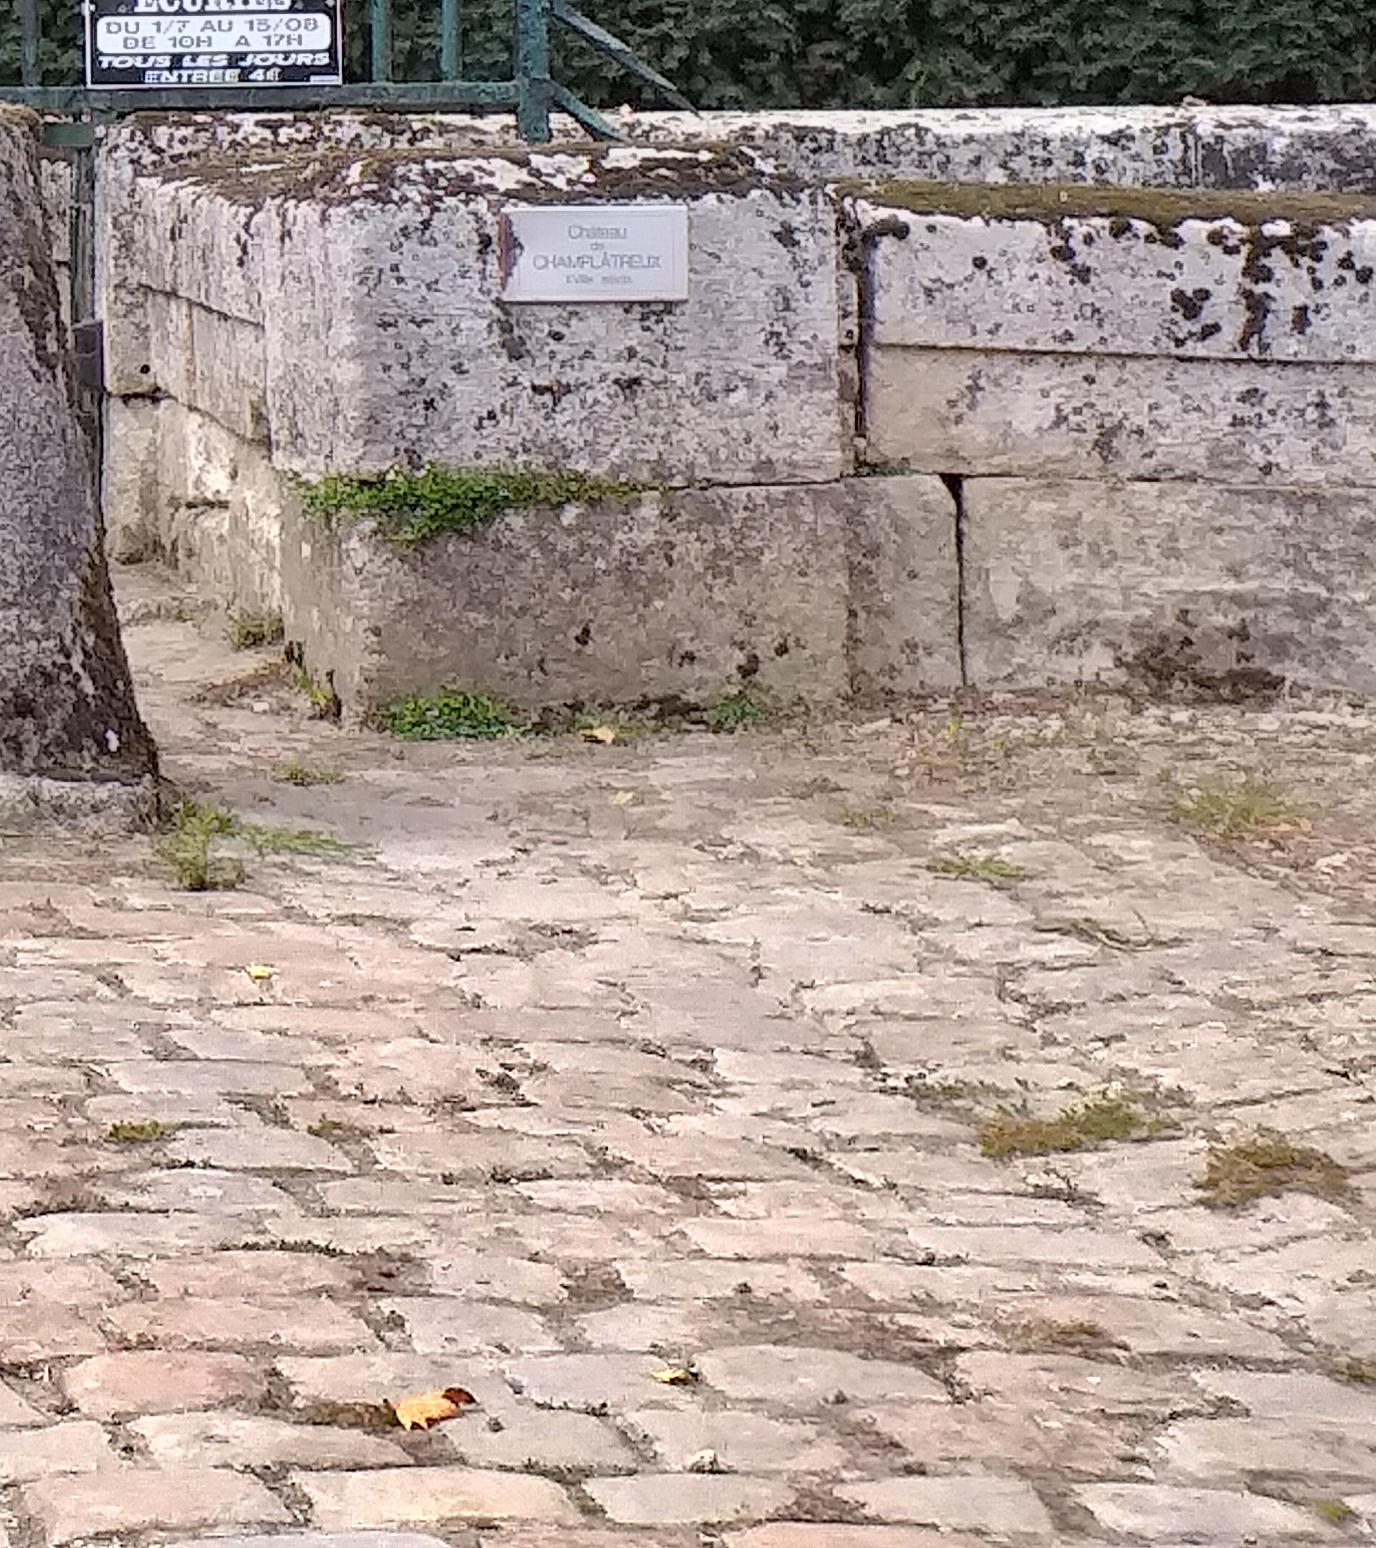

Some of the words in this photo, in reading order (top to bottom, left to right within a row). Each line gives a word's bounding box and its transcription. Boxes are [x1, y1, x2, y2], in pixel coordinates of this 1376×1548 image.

[105, 21, 140, 34] DU
[152, 20, 190, 34] 1/7
[200, 20, 233, 33] AU
[245, 18, 319, 33] 15/08
[123, 36, 156, 49] DE
[167, 35, 213, 48] 10H
[235, 35, 251, 47] A
[262, 34, 303, 47] 17H
[98, 55, 172, 69] TOUS
[182, 55, 229, 68] LES
[237, 53, 330, 67] JOURS
